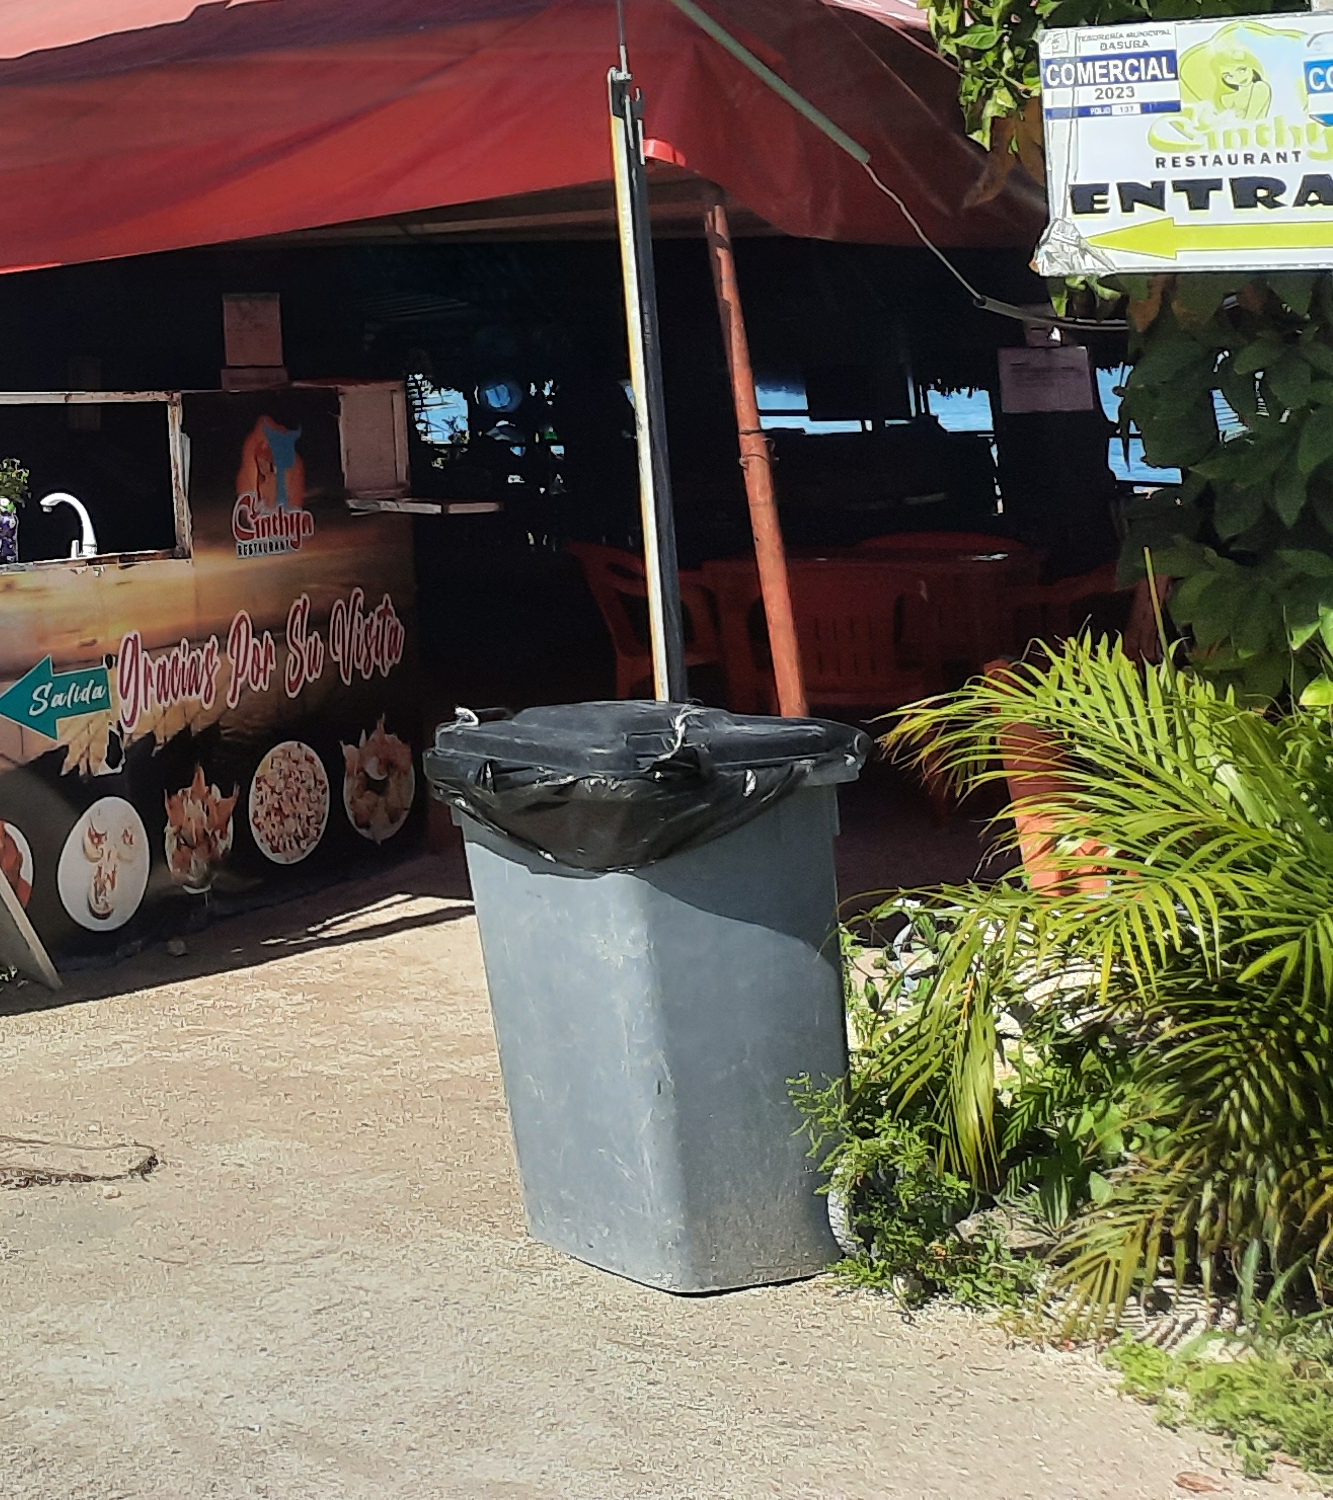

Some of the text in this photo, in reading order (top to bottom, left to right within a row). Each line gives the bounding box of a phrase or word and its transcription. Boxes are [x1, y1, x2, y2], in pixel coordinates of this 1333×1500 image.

[1045, 56, 1176, 87] COMERCIAL
[1094, 86, 1135, 100] 2023
[1155, 151, 1302, 169] RESTAURANT
[1069, 174, 1333, 215] ENTRA
[233, 492, 314, 551] Cinthya
[226, 608, 277, 709] Por
[284, 592, 325, 700] Su
[329, 586, 405, 687] Visita
[28, 679, 107, 717] Salida
